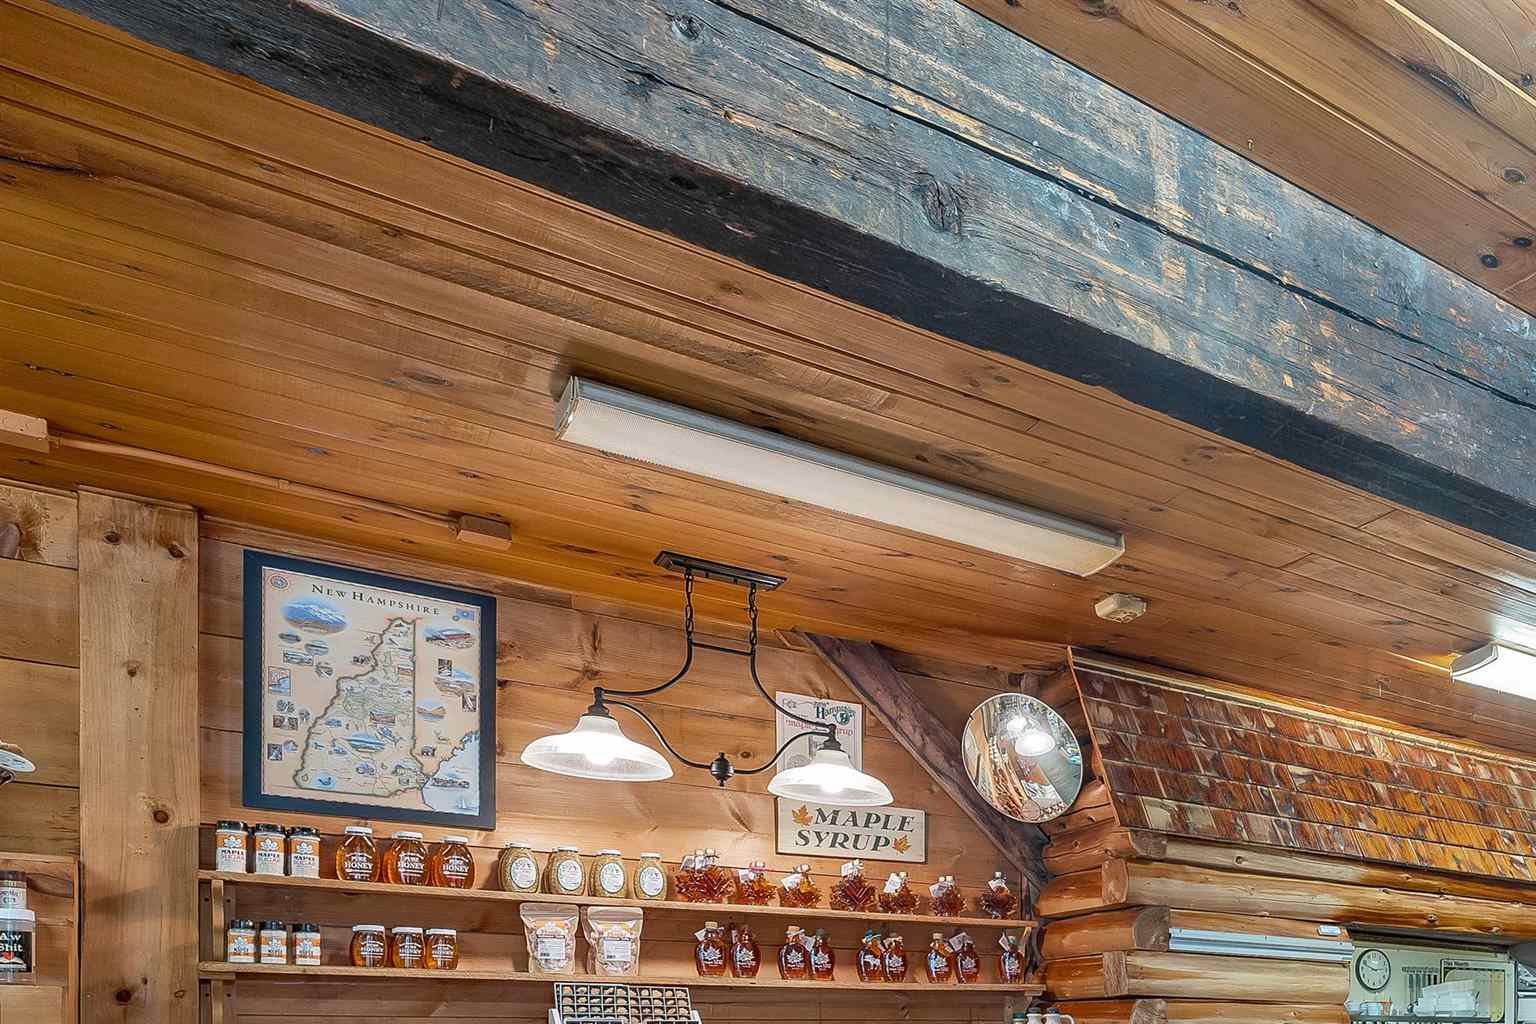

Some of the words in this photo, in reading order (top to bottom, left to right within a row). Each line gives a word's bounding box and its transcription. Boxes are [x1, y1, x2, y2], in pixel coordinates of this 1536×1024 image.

[352, 591, 441, 615] HAMPSHIRE
[814, 807, 916, 833] MAPLE
[795, 830, 891, 852] SYRUP
[344, 861, 374, 870] HONEY
[397, 861, 425, 871] HONEY
[442, 864, 469, 873] HONEY
